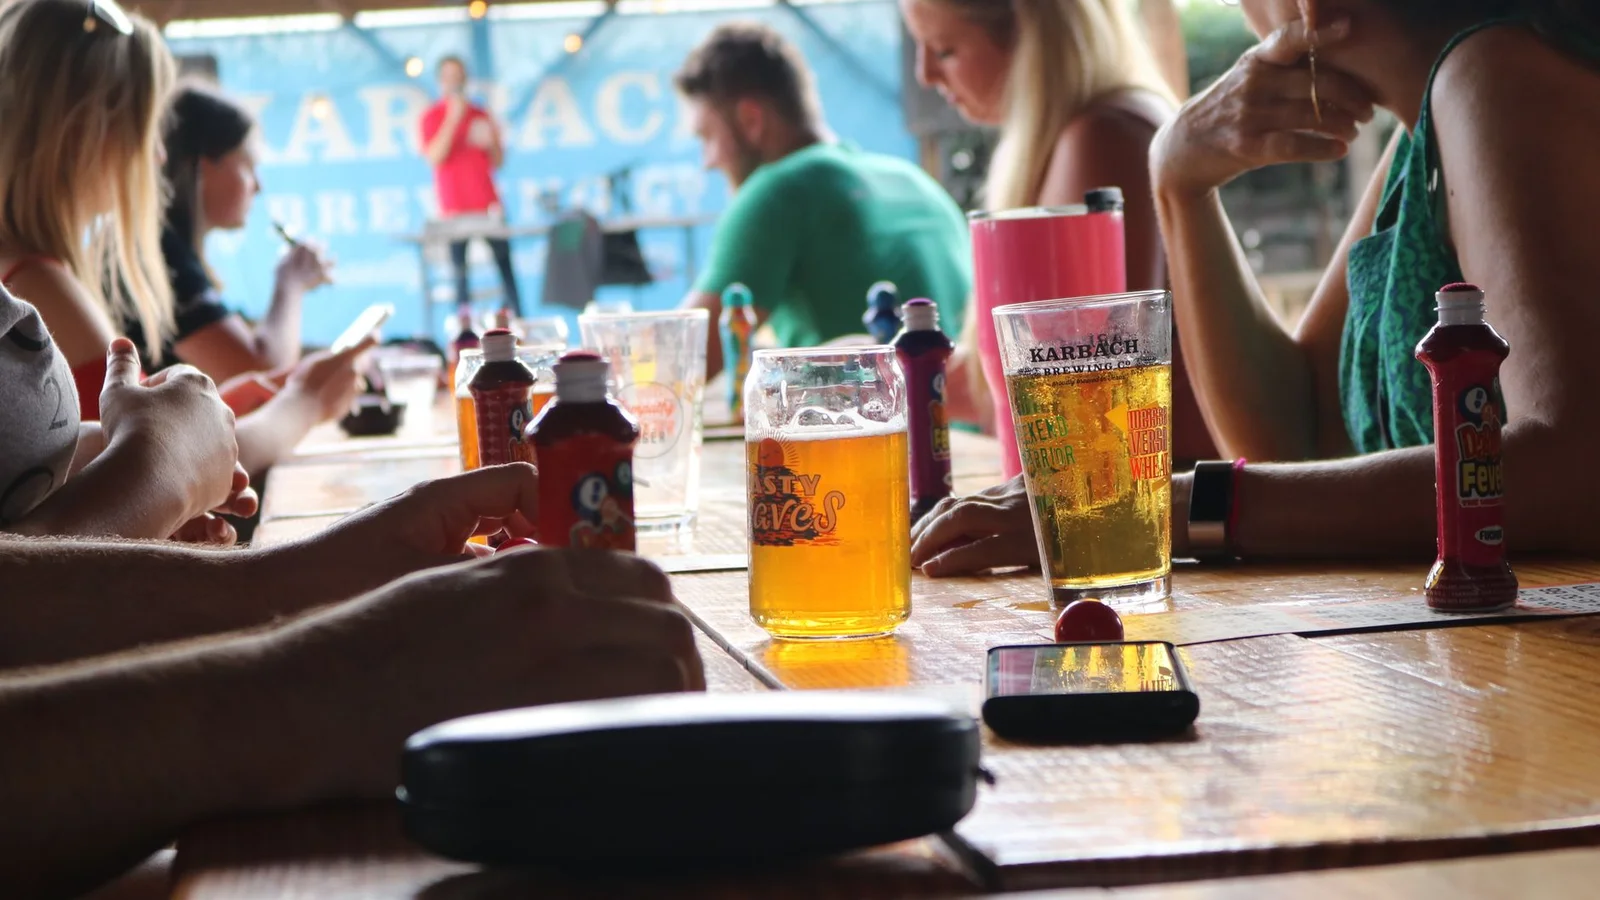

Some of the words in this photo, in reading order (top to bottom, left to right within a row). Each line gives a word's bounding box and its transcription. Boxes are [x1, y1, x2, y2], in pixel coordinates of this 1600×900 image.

[1030, 339, 1139, 362] KARBACH
[1043, 362, 1113, 375] BREWING
[43, 376, 68, 431] 2
